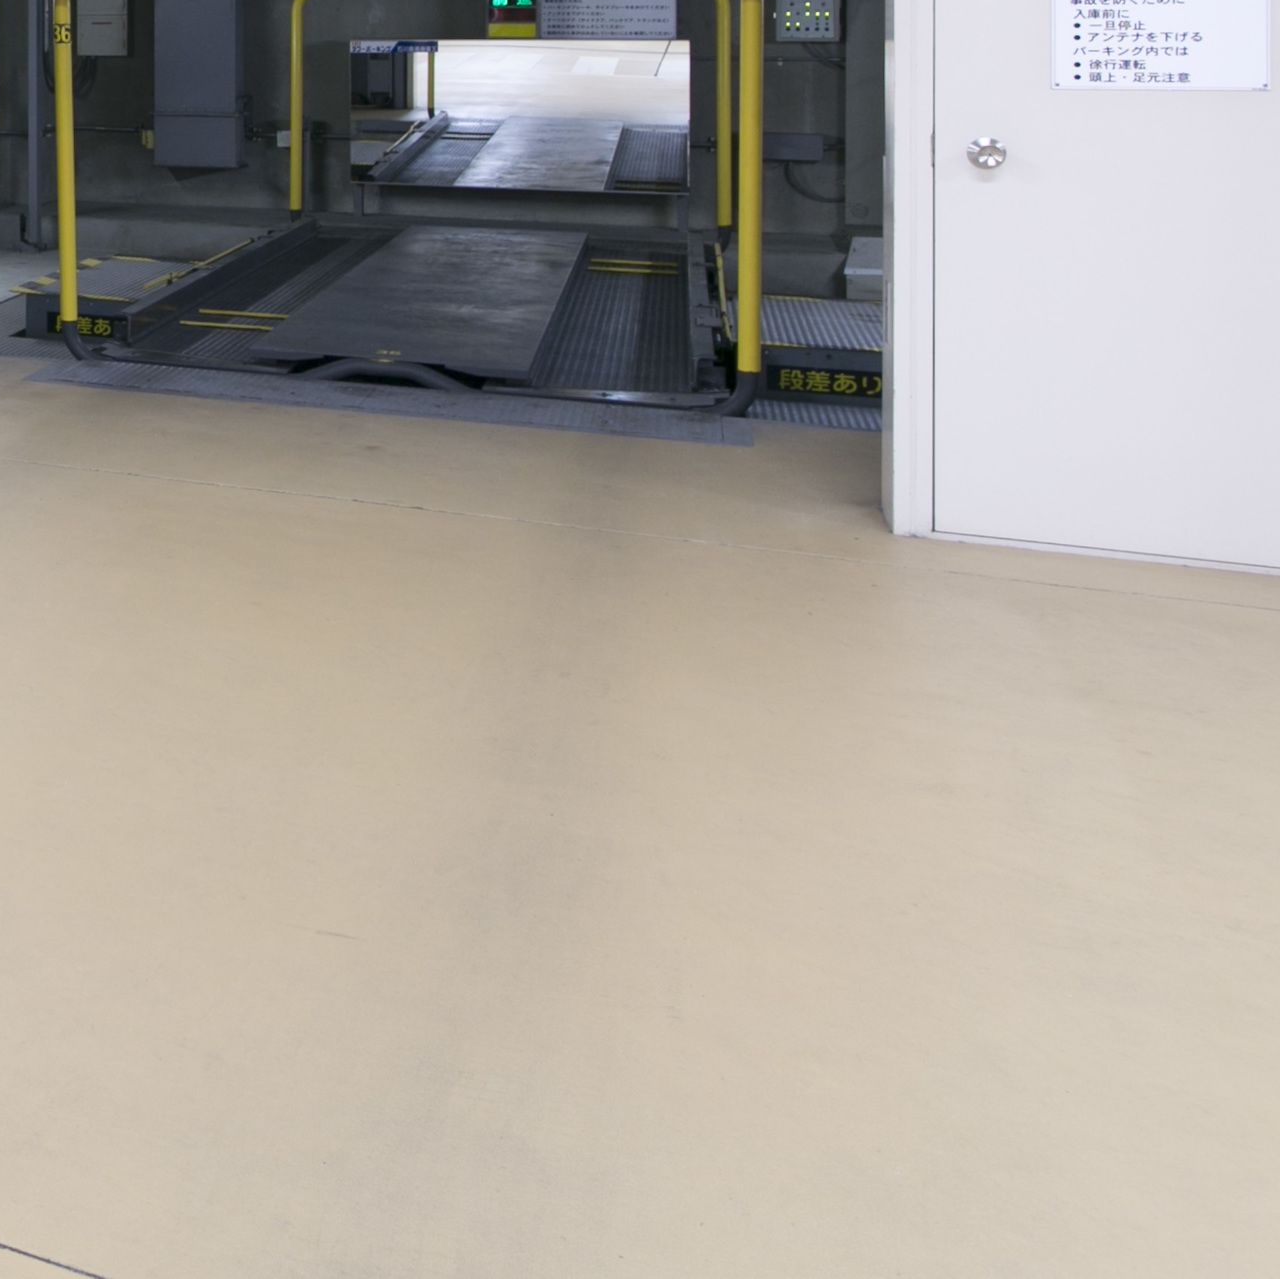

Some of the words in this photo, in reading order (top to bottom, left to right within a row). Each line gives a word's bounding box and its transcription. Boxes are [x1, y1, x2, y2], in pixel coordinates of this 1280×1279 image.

[1074, 9, 1130, 19] 入庫前に
[1089, 20, 1146, 31] 一旦停止
[1088, 32, 1203, 43] アンテナを下げる
[1073, 46, 1189, 56] パーキング内では
[1089, 59, 1146, 70] 徐行運転
[1089, 72, 1191, 83] 頭上・足元注意
[778, 369, 882, 395] 段差あり
